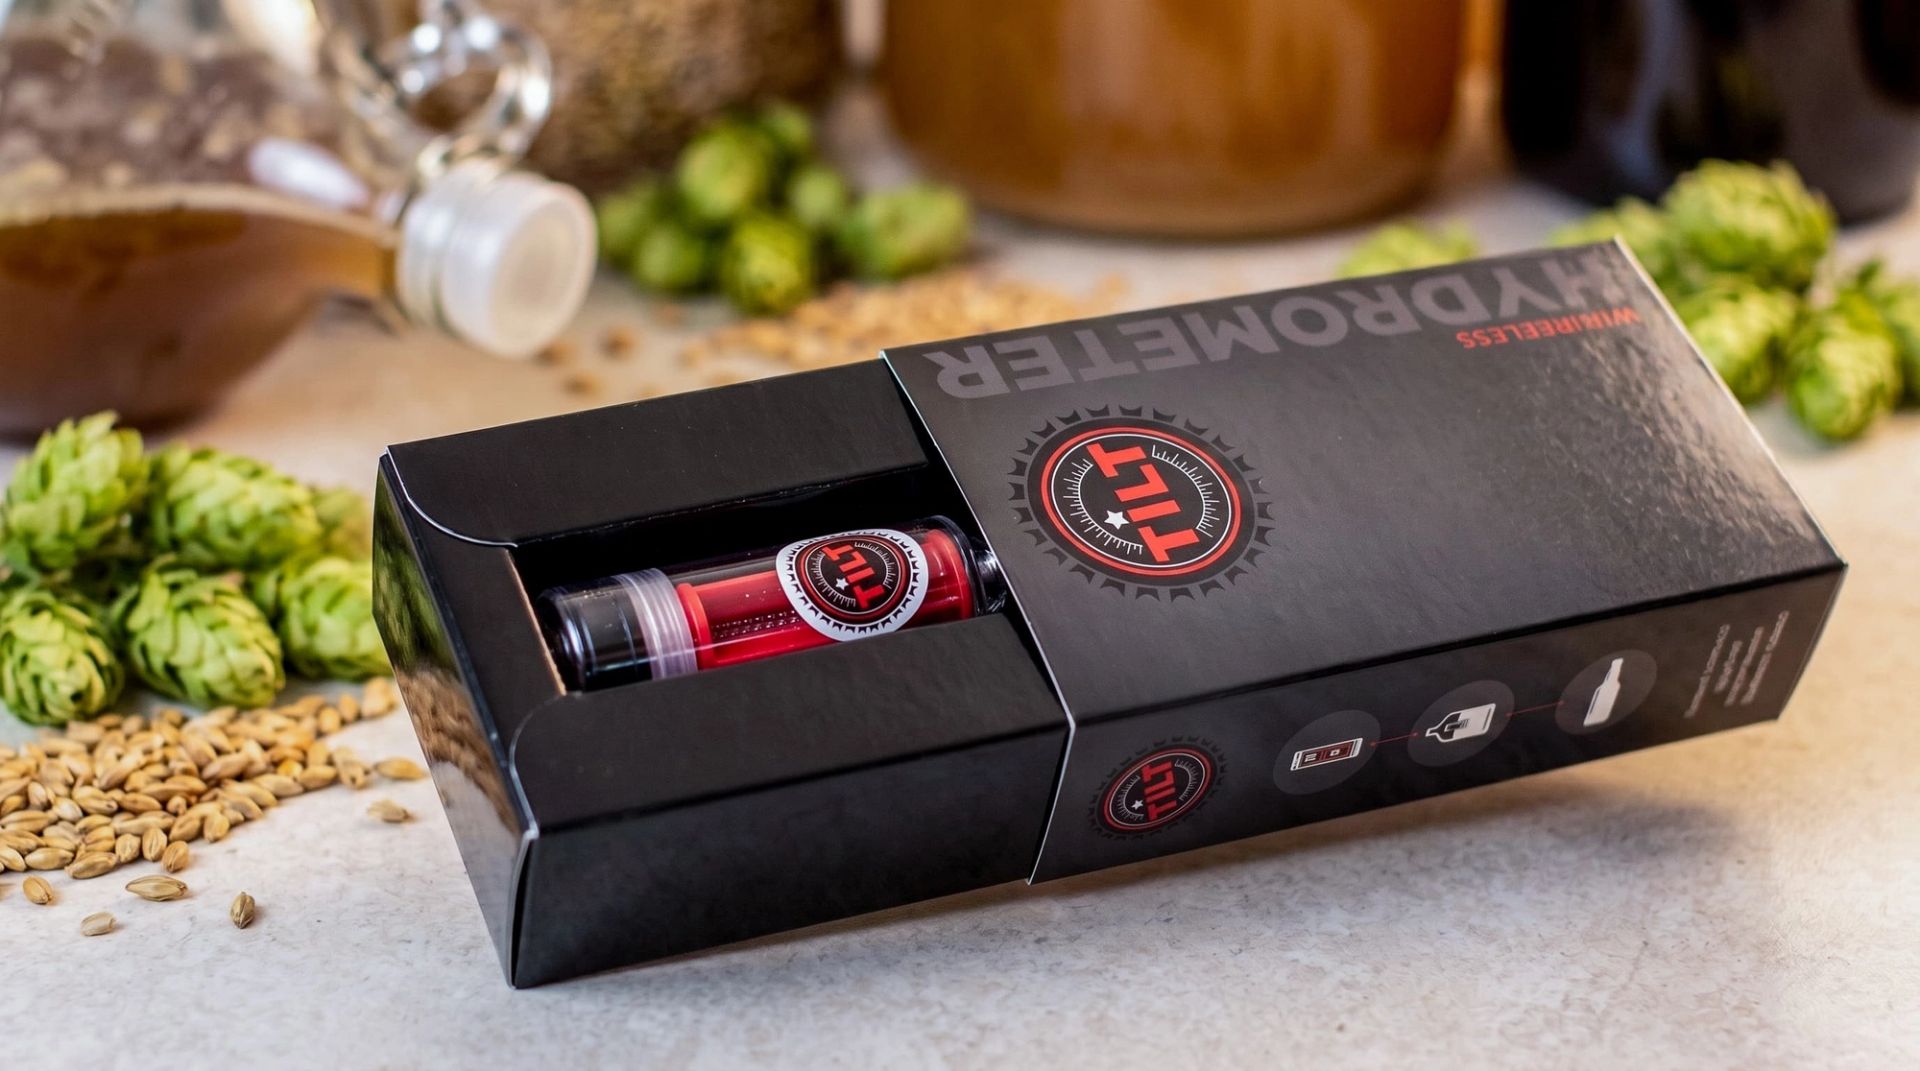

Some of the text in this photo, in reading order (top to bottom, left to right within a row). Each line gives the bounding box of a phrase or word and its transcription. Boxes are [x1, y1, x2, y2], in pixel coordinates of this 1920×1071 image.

[921, 253, 1624, 399] HYDROMETER
[1086, 443, 1200, 563] TILT
[822, 544, 885, 609] TILT
[1142, 761, 1177, 820] TILT
